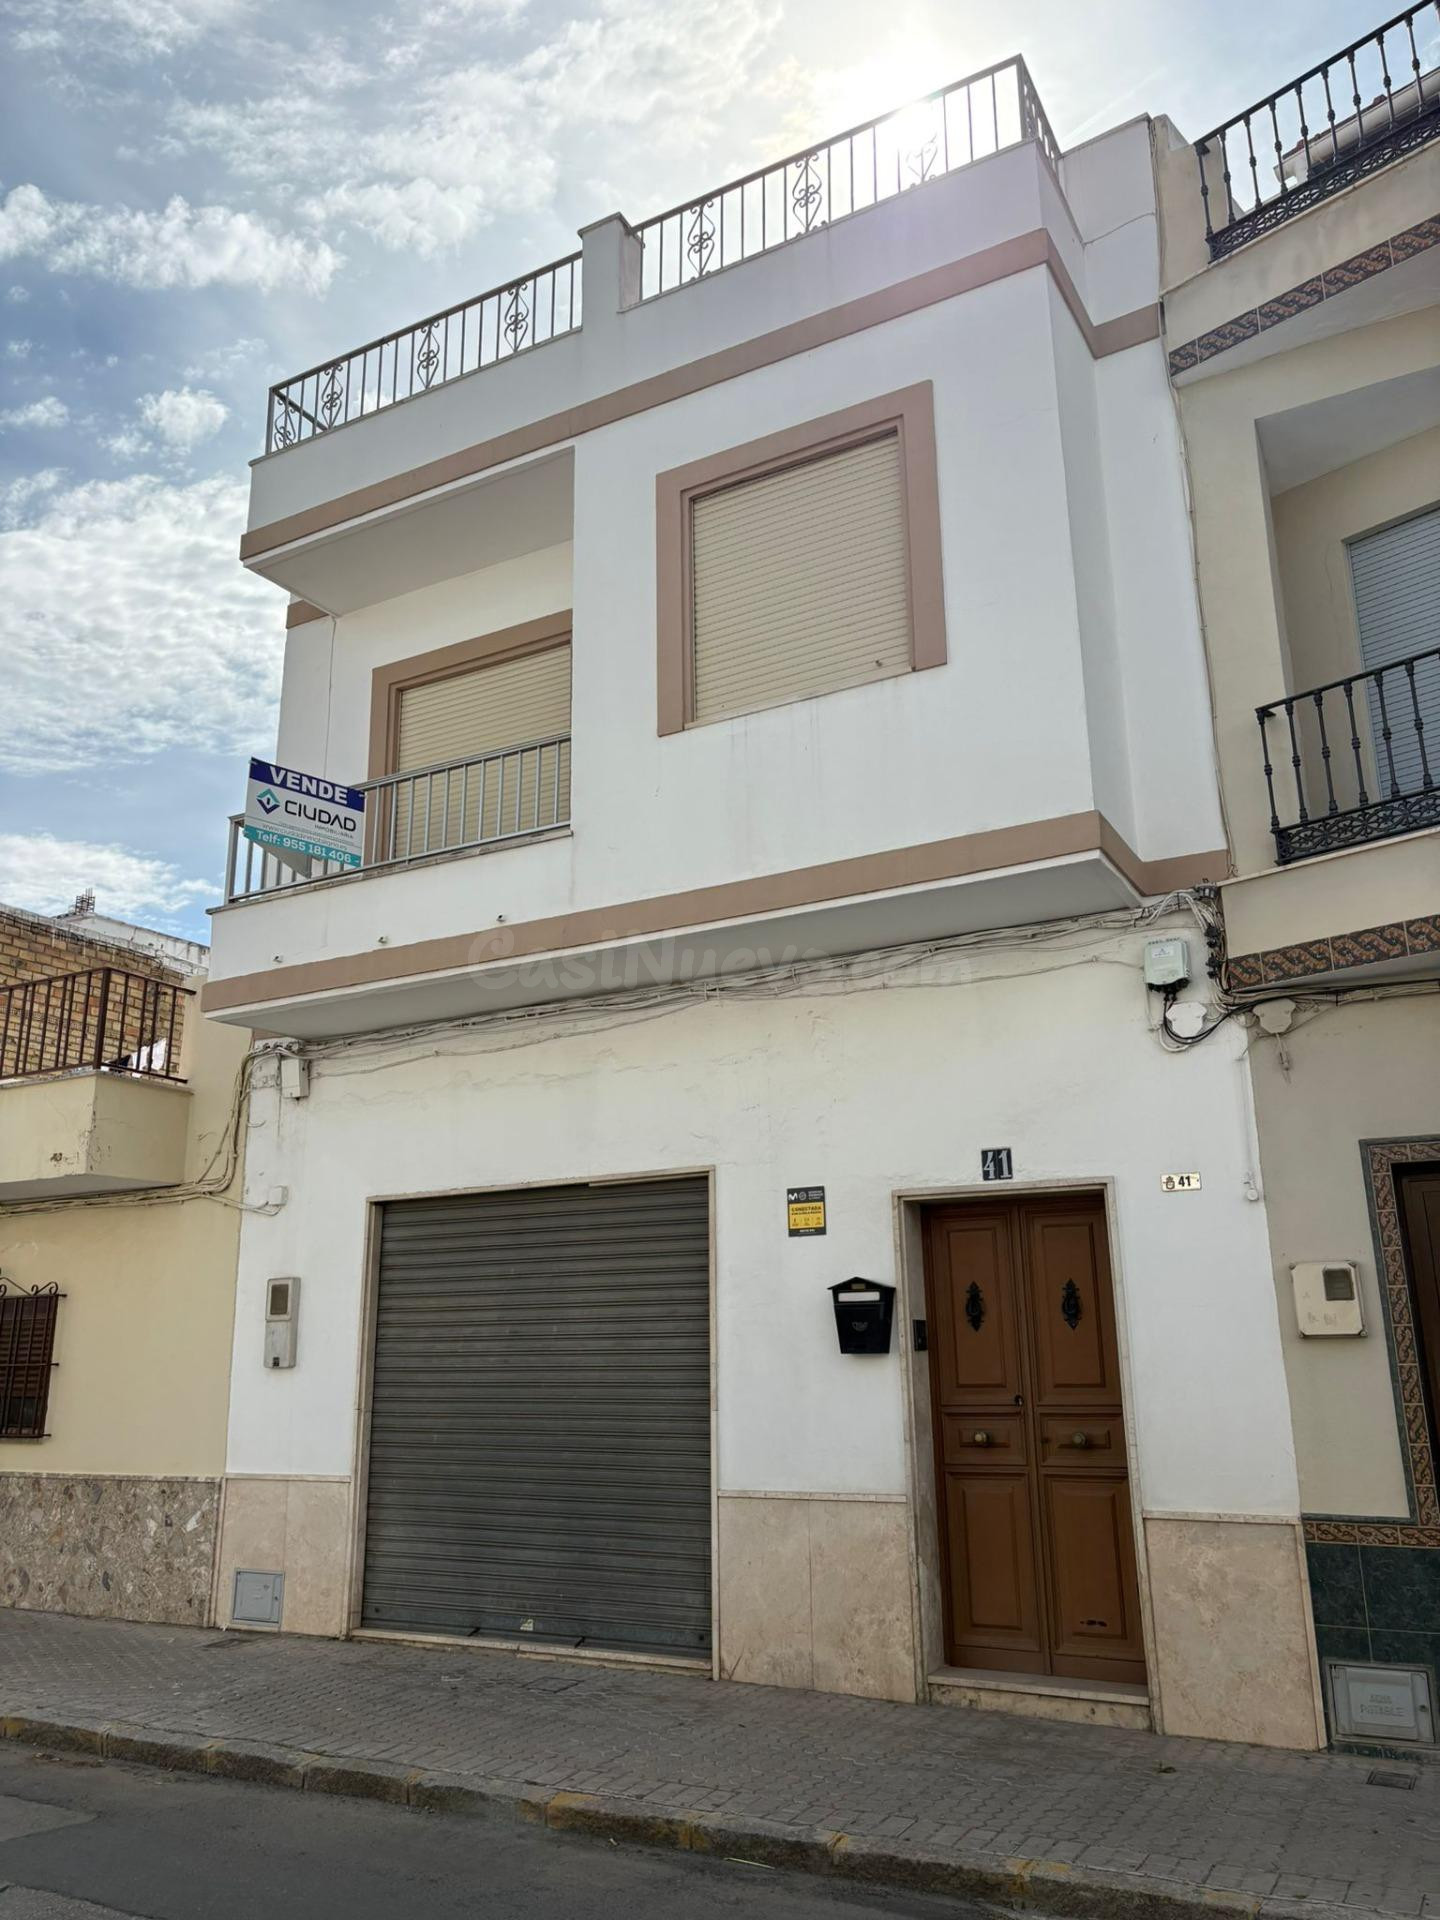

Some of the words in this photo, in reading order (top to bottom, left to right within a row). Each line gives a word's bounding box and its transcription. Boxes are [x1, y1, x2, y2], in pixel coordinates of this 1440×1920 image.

[269, 766, 348, 804] VENDE
[284, 799, 357, 832] CIUDAD
[256, 829, 281, 845] Telf:
[282, 837, 306, 852] 955
[308, 844, 327, 857] 181
[328, 848, 352, 863] 406
[983, 1150, 1012, 1179] 41
[1178, 1175, 1191, 1187] 41
